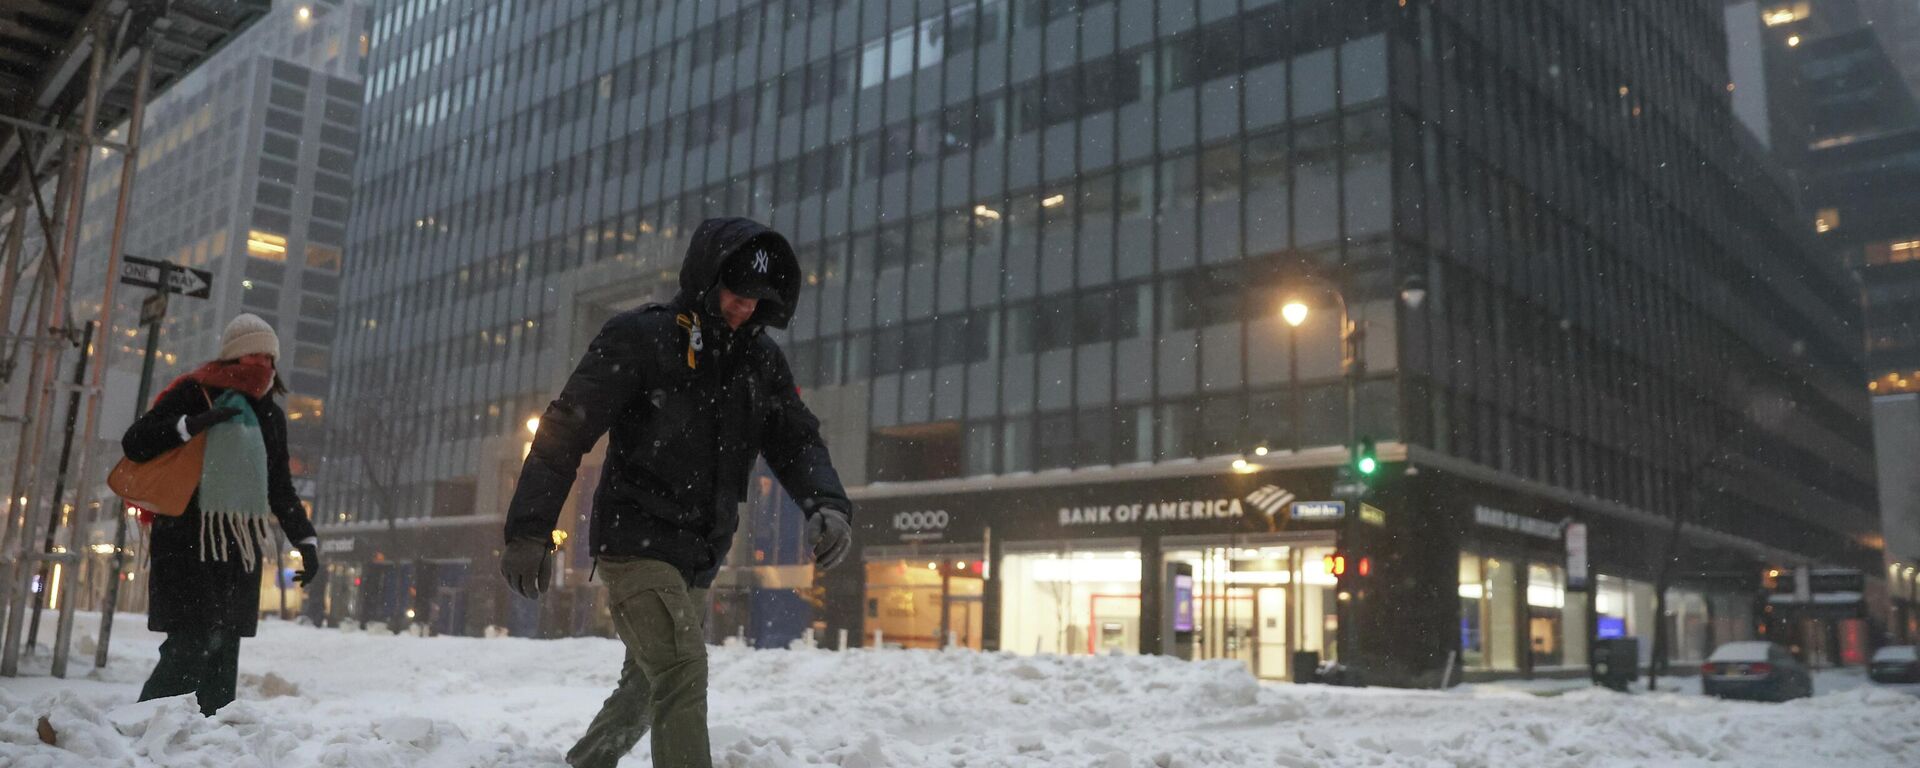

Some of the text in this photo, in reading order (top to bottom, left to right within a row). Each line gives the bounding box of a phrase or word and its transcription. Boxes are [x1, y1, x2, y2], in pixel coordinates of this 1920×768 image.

[124, 263, 196, 287] ONE WAY
[1059, 499, 1243, 525] BANK OF AMERICA
